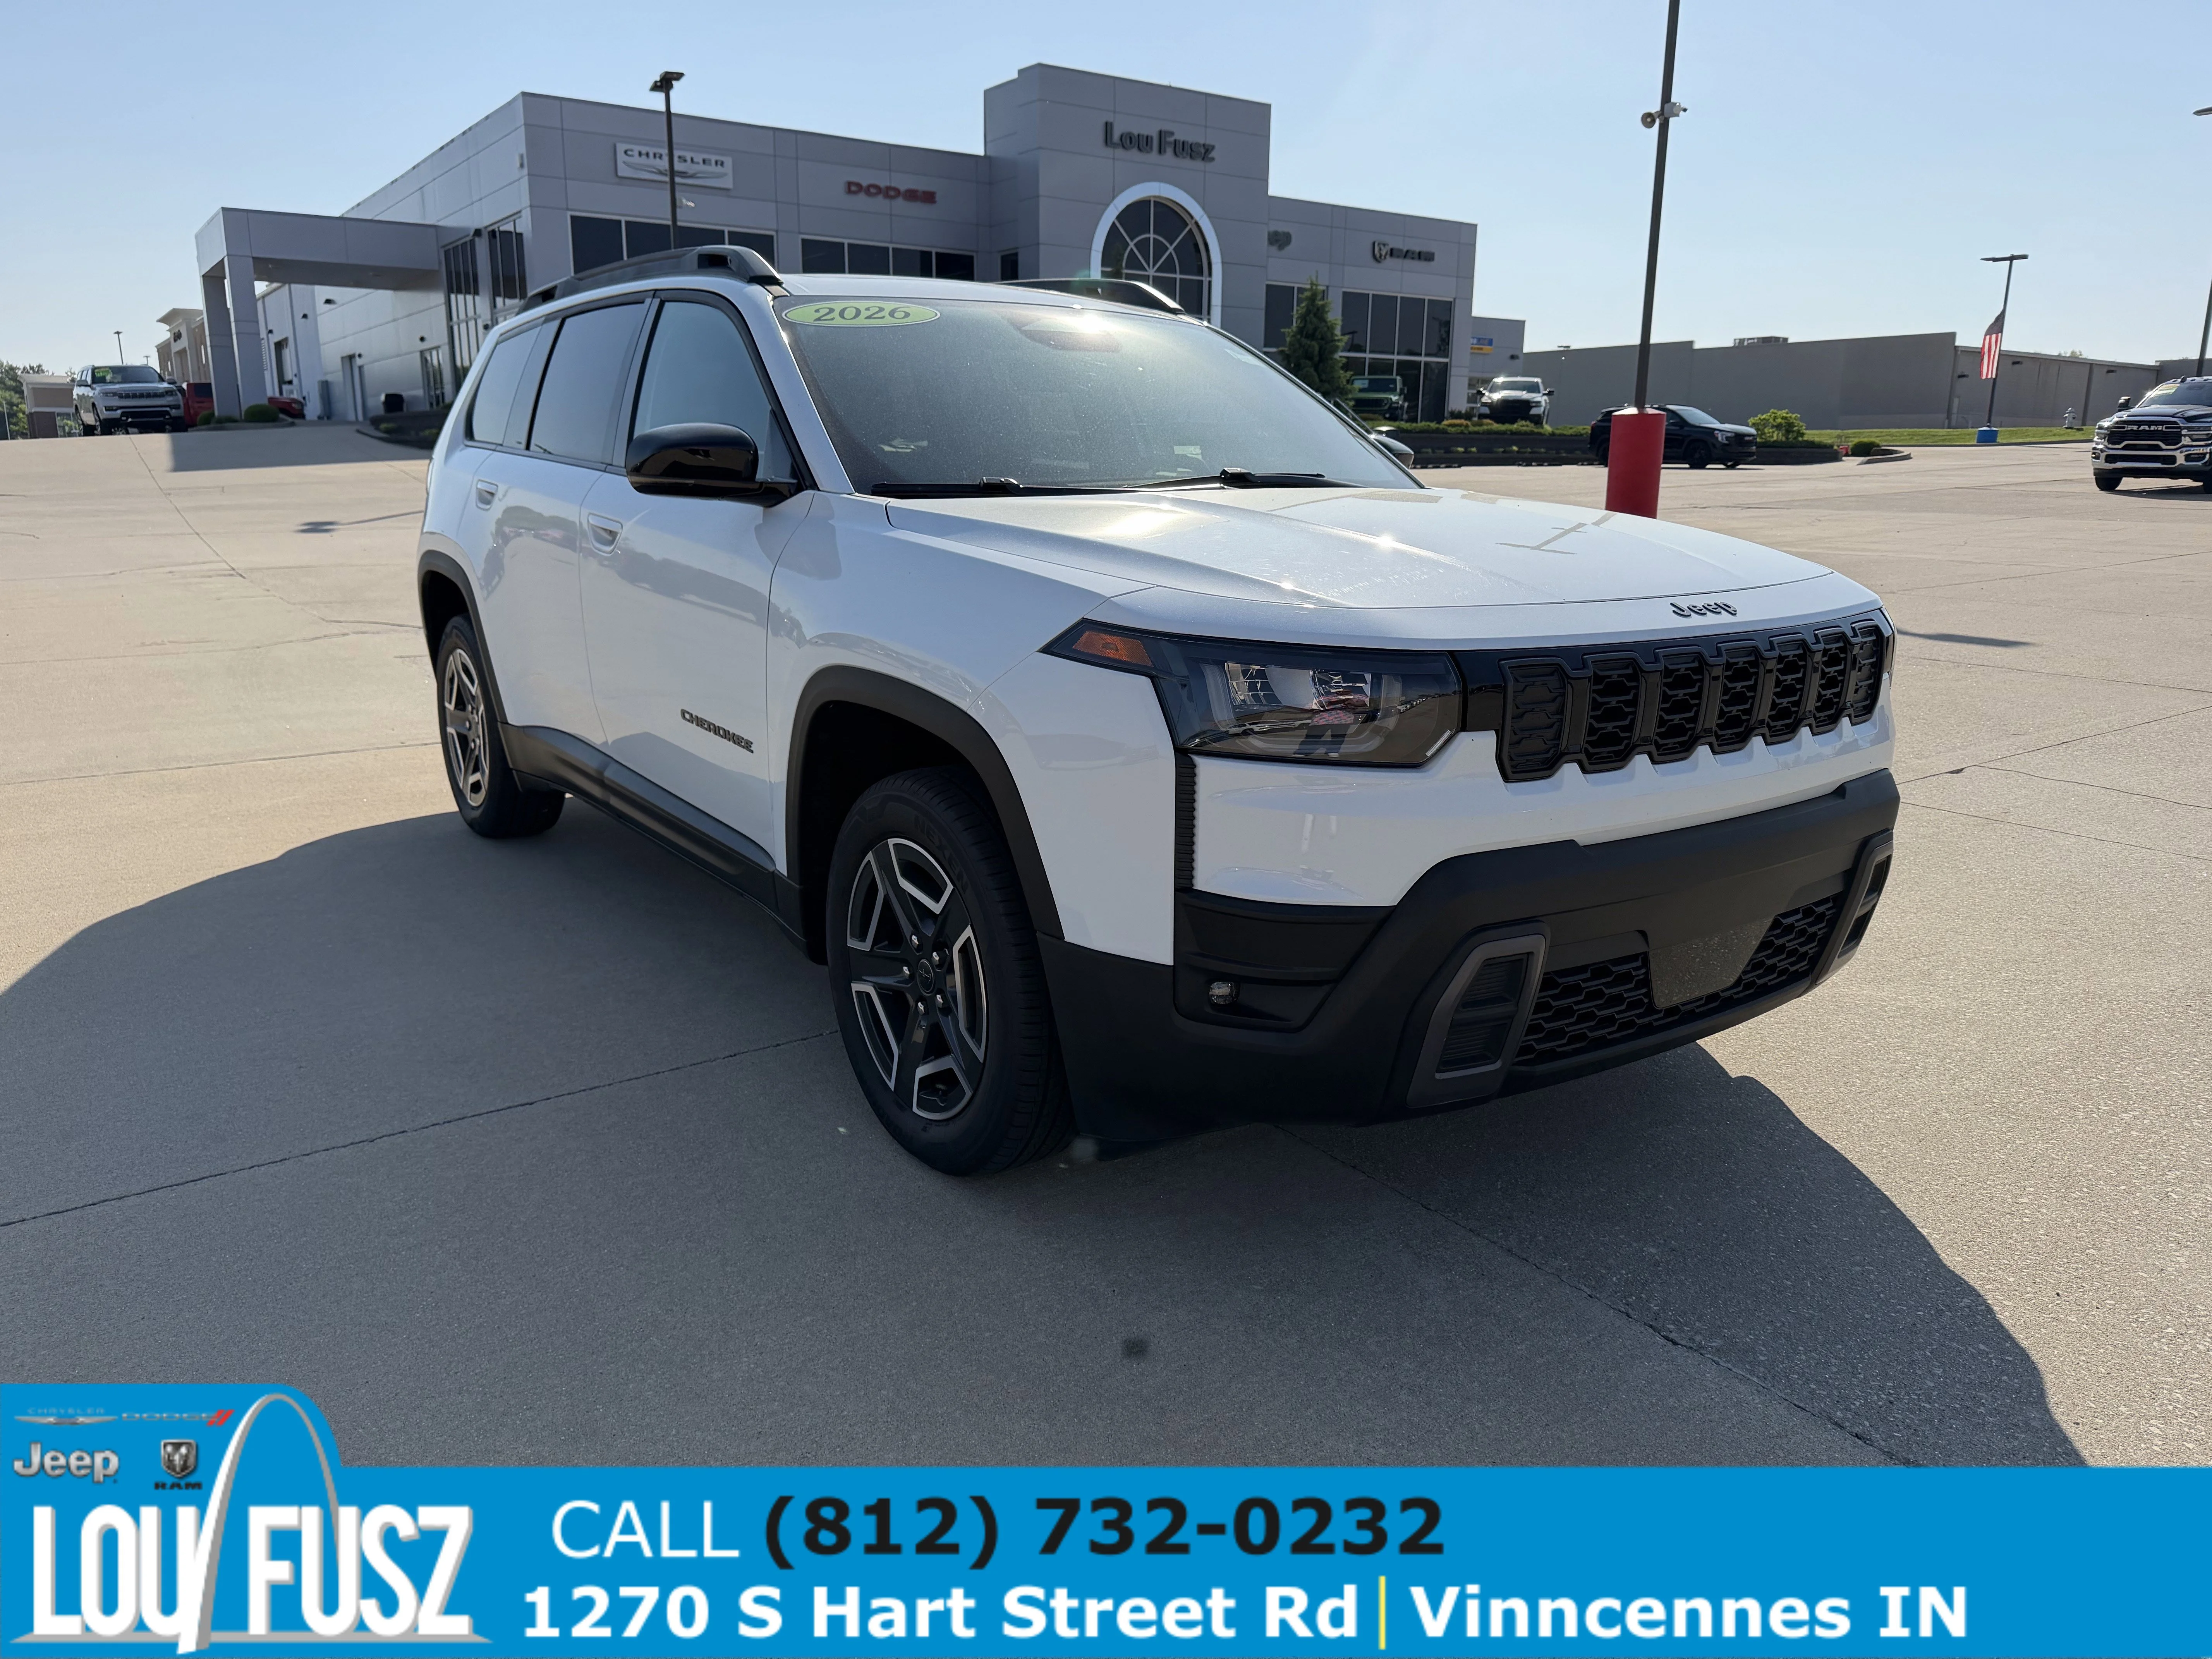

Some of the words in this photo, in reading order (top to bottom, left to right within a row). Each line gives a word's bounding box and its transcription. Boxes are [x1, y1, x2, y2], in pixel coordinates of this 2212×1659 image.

[1104, 121, 1154, 153] Lou
[1158, 129, 1216, 162] Fusz
[623, 148, 725, 168] CHRSLER
[845, 180, 938, 204] DODGE
[813, 306, 911, 322] 2026
[1670, 601, 1737, 618] Jeep
[680, 708, 754, 754] CHEROKEE
[913, 814, 969, 895] NEXEN
